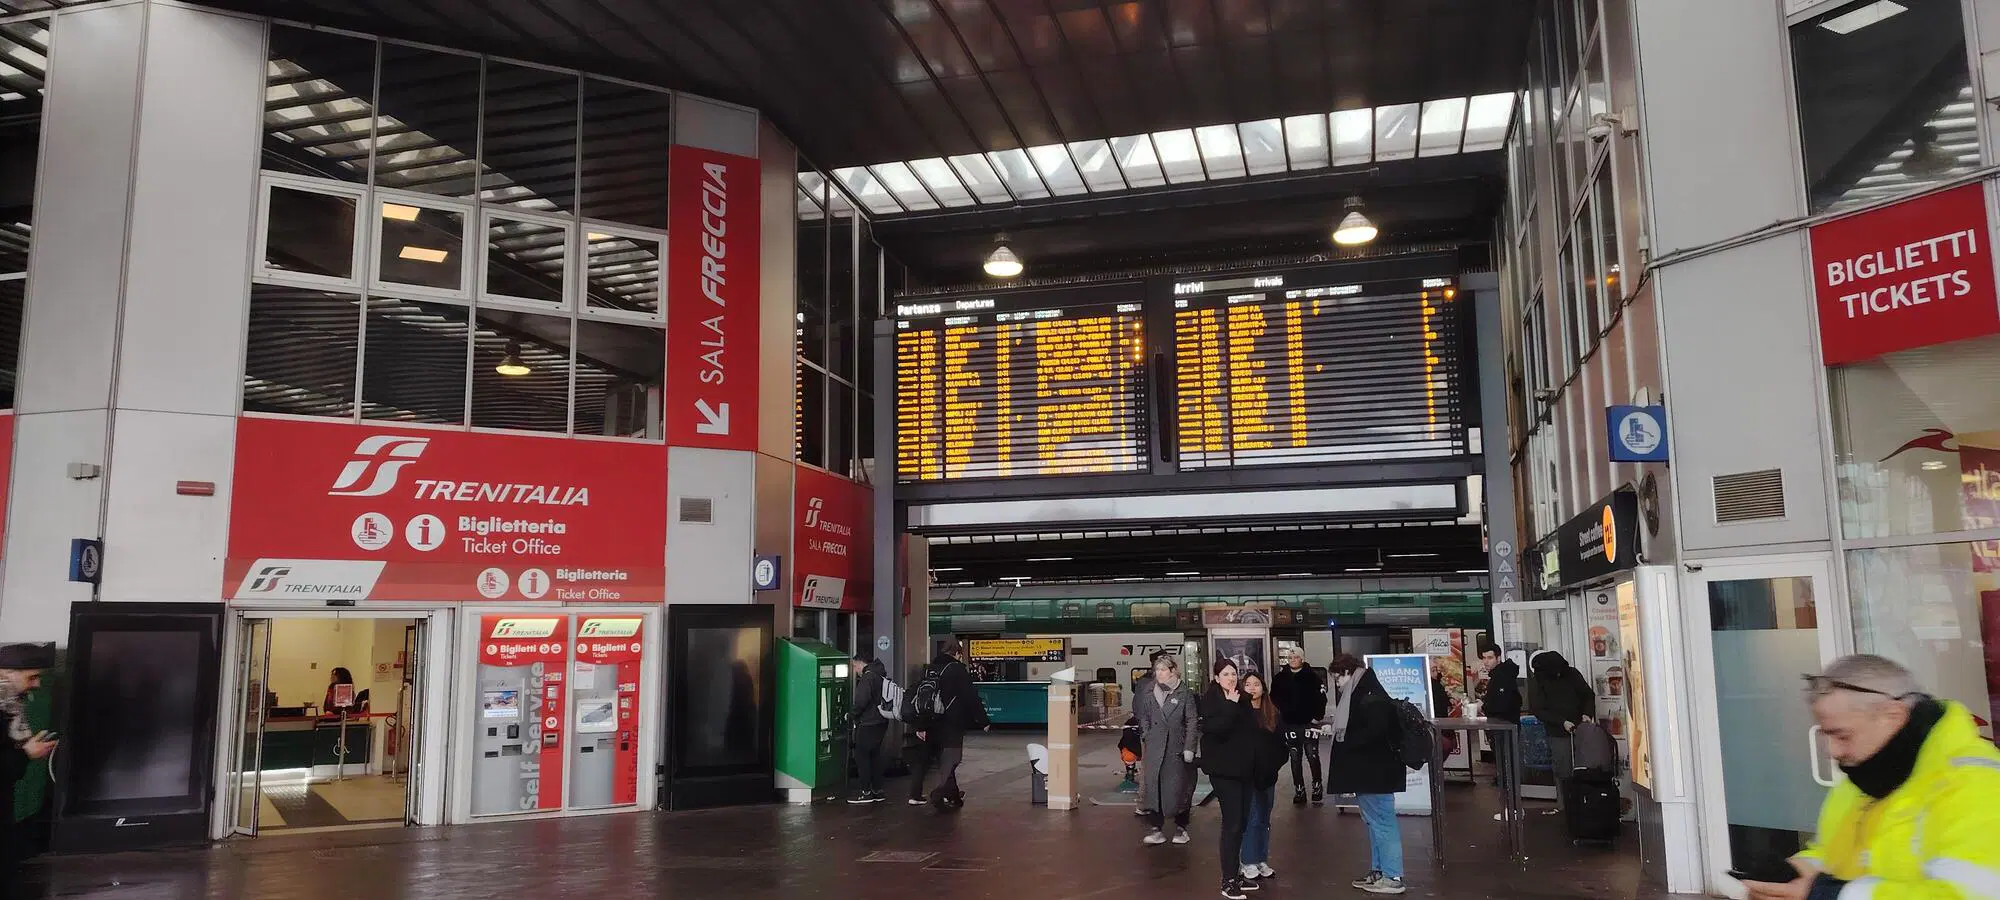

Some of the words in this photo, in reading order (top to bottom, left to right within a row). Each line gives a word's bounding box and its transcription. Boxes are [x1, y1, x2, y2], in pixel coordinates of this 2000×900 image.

[701, 162, 727, 307] FRECCIA
[1827, 228, 1977, 287] BIGLIETTI
[1174, 282, 1203, 294] Arrivi
[1254, 277, 1283, 287] Arrivals
[1839, 269, 1971, 319] TICKETS
[956, 300, 995, 310] Departures
[700, 315, 725, 385] SALA
[413, 479, 590, 507] TRENITALIA
[457, 516, 567, 536] Biglietteria
[818, 520, 851, 536] TRENITALIA
[462, 537, 507, 554] Ticket
[512, 539, 561, 556] Office
[809, 538, 822, 551] SALA
[822, 541, 847, 556] FRECCIA
[556, 569, 627, 583] Biglietteria
[284, 584, 363, 594] TRENITALIA
[556, 588, 586, 600] Ticket
[589, 590, 620, 600] Office
[500, 644, 536, 655] Biglietti
[592, 643, 627, 654] Biglietti
[1378, 667, 1420, 677] MILANO
[522, 662, 545, 755] Service
[520, 761, 540, 809] Self
